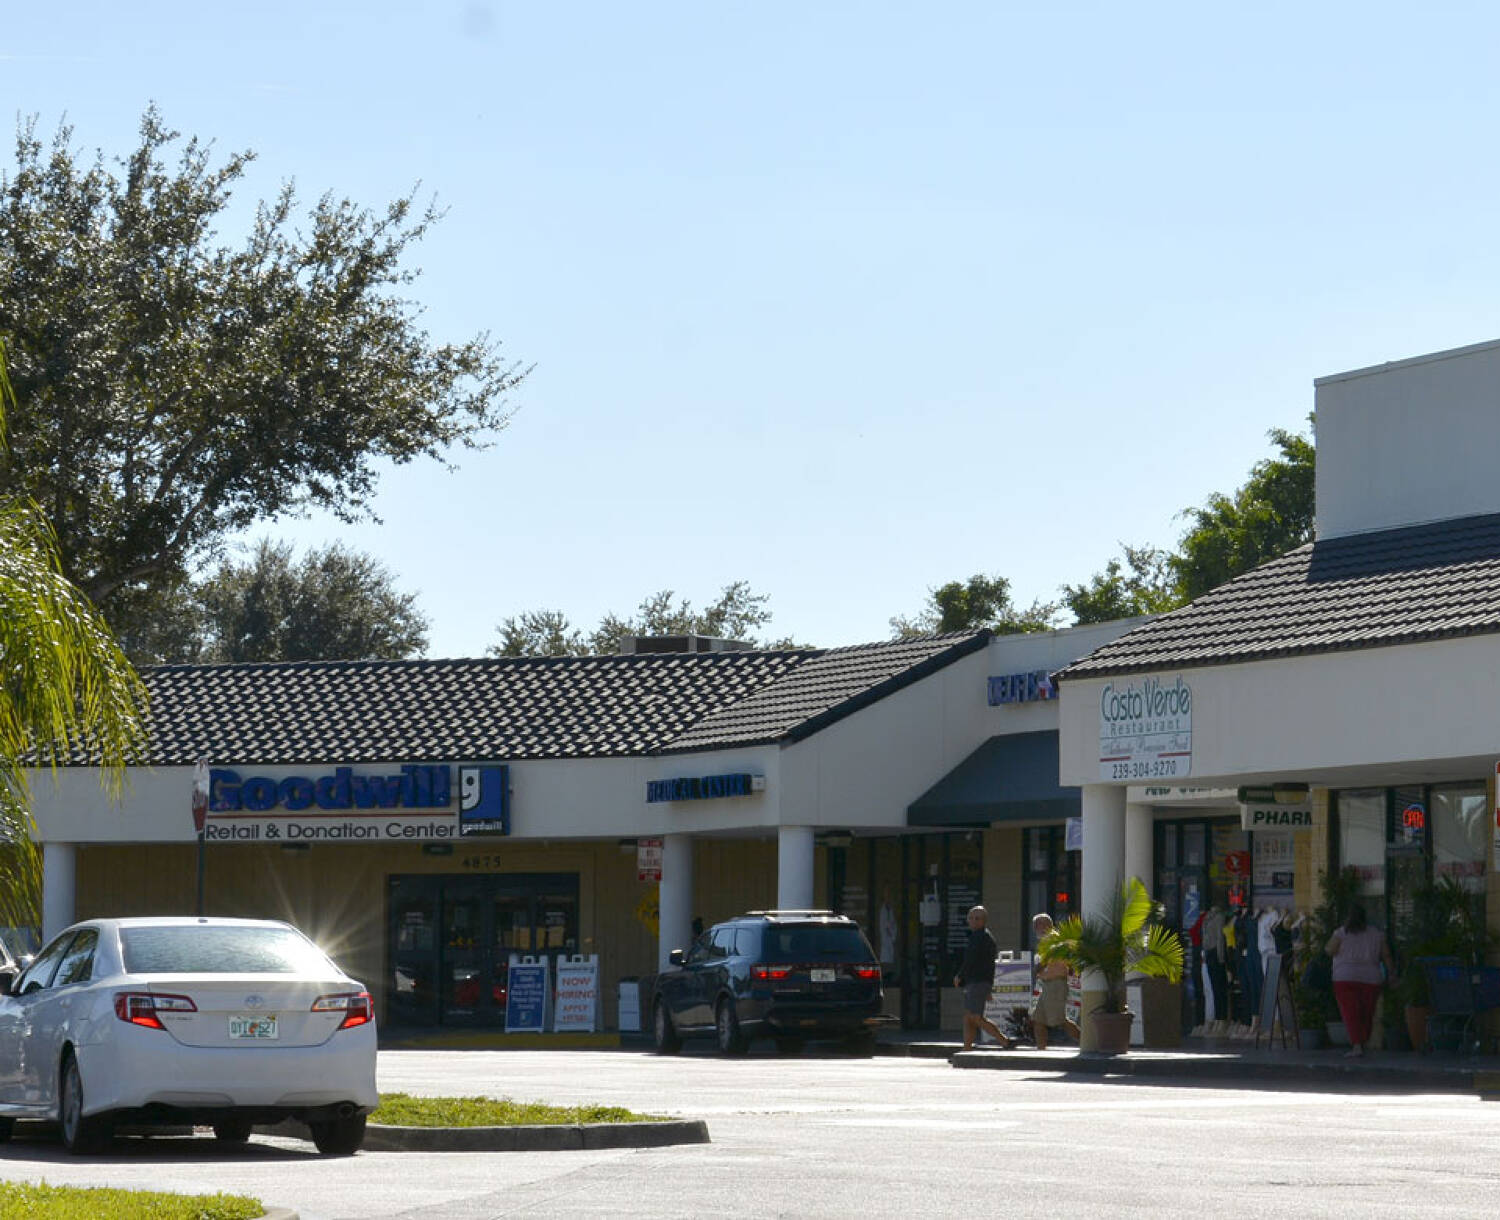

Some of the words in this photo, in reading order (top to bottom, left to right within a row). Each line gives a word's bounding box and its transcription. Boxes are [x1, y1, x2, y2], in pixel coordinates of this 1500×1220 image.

[1102, 682, 1142, 722] Costa
[1145, 677, 1190, 718] Verde
[1110, 719, 1181, 737] Restaurant
[1112, 761, 1177, 779] 239-304-9270
[209, 765, 450, 812] Goodwill
[206, 824, 260, 840] Retail
[265, 825, 280, 839] &
[287, 823, 380, 840] Donation
[386, 822, 456, 839] Center
